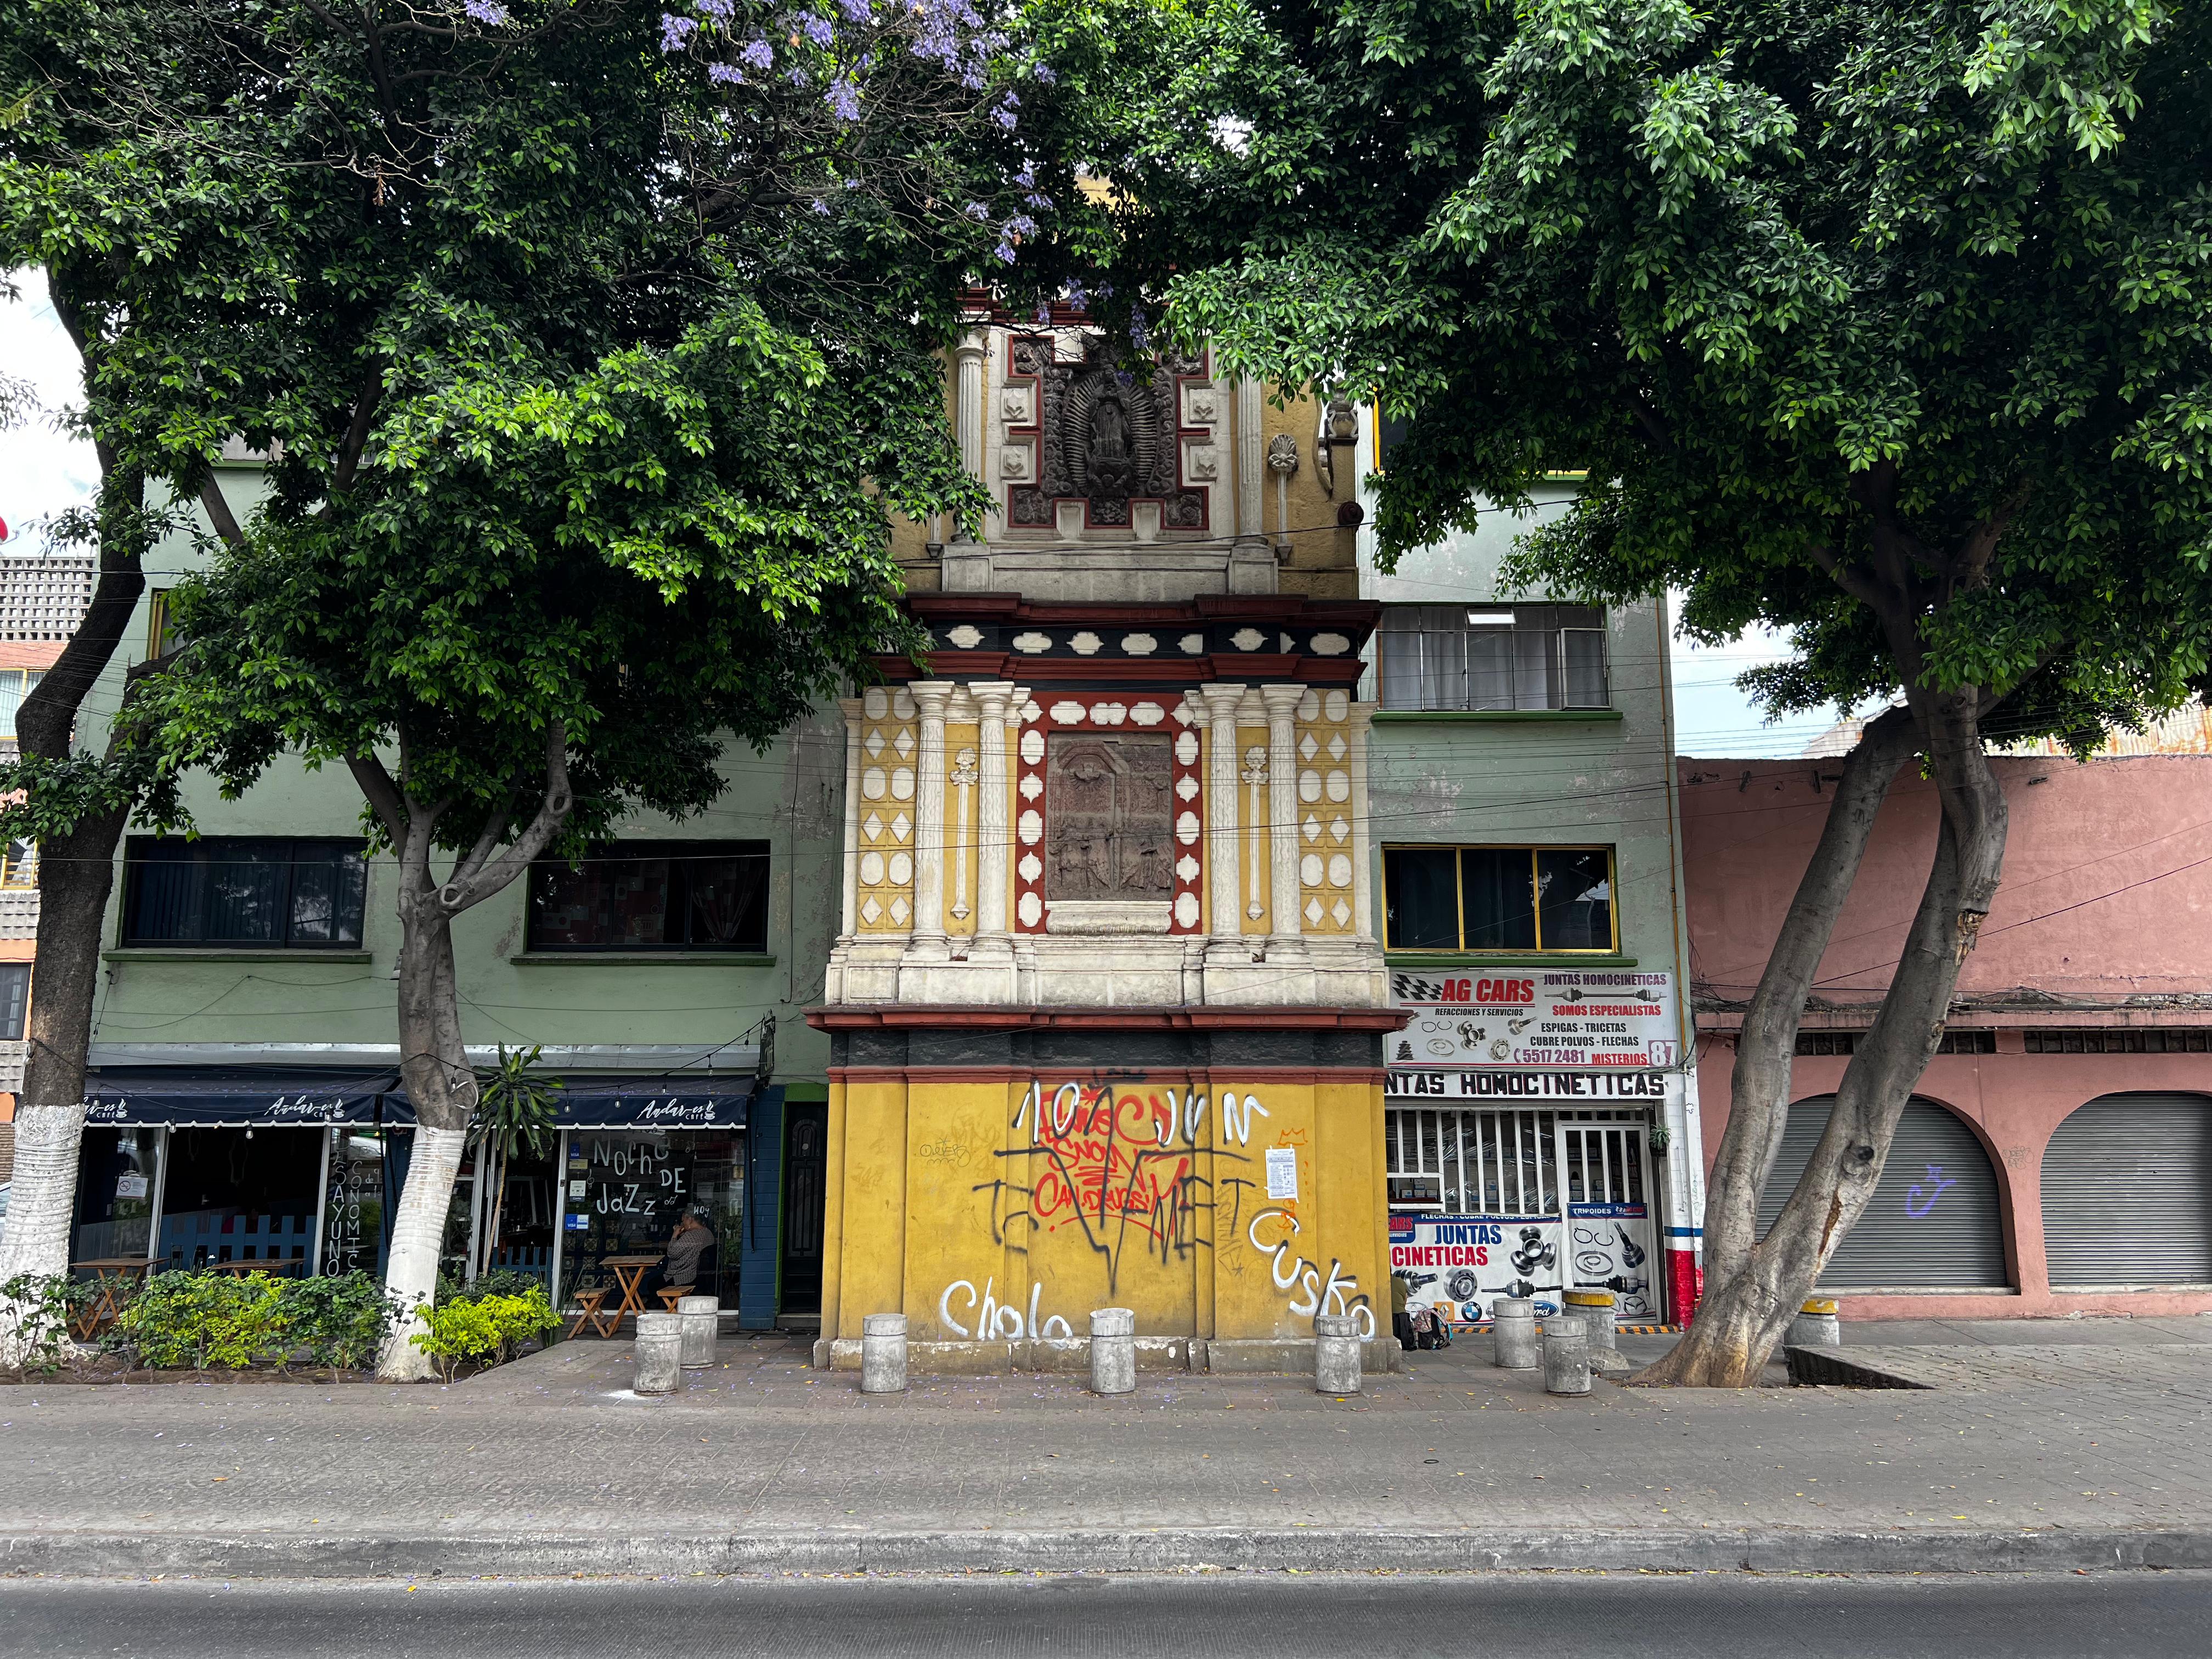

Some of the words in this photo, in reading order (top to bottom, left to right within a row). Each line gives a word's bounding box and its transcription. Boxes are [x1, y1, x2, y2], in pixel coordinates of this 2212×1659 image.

[1441, 979, 1471, 1002] AG
[1476, 979, 1535, 1002] CARS
[1544, 974, 1581, 985] JUNTAS
[1583, 974, 1667, 986] HOMOCINETICAS
[1553, 1005, 1587, 1015] SOMOS
[1589, 1005, 1661, 1015] ESPECIALISTAS
[1541, 1023, 1578, 1032] ESPIGAS
[1585, 1023, 1627, 1032] TRICETAS
[1530, 1036, 1559, 1046] CUBRE
[1561, 1036, 1594, 1046] POLVOS
[1601, 1036, 1639, 1046] FLECHAS
[1522, 1049, 1551, 1063] 5517
[1554, 1049, 1585, 1063] 2481
[1592, 1053, 1647, 1064] MISTERIOS
[1650, 1041, 1673, 1066] 87
[1384, 1073, 1444, 1095] NTAS
[1460, 1073, 1665, 1096] HOMOCINETICAS
[659, 1167, 686, 1193] DE
[347, 1160, 363, 1277] CONOMIC
[1389, 1217, 1413, 1231] ARS
[1435, 1224, 1502, 1245] JUNTAS
[1389, 1246, 1488, 1267] CINETICAS
